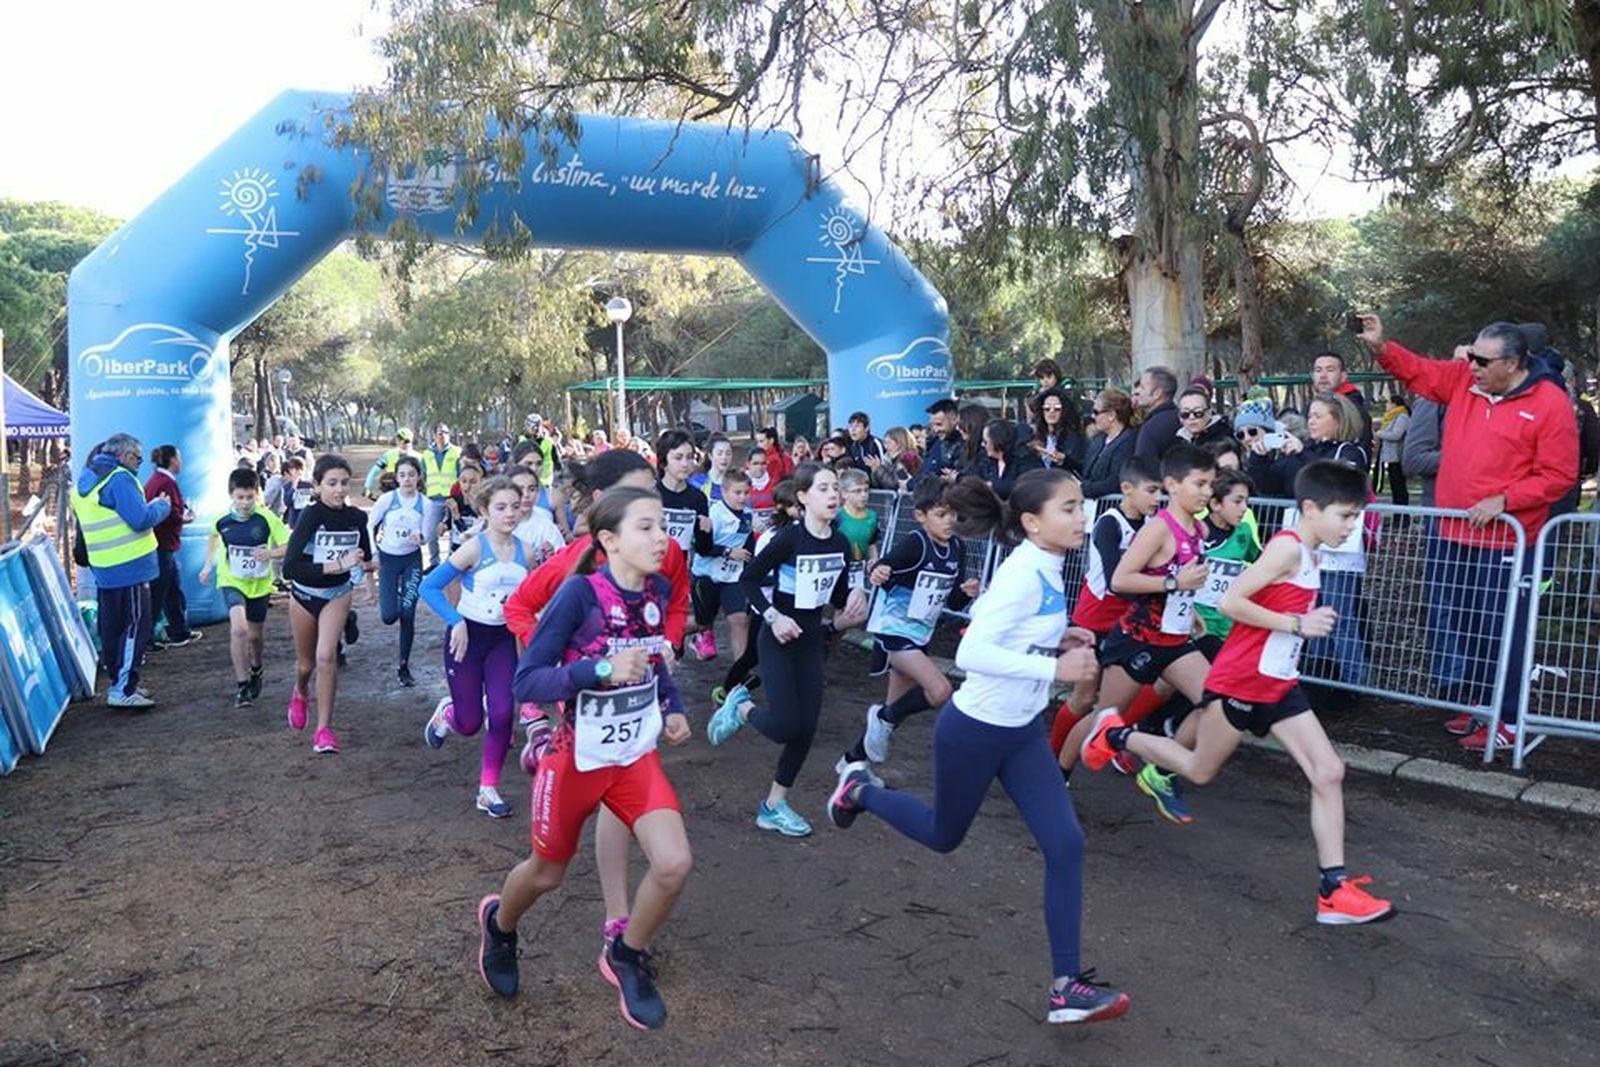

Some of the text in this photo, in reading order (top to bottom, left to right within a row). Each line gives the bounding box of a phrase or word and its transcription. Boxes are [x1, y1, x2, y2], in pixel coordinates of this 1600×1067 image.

[242, 559, 256, 569] 20
[1211, 579, 1230, 593] 30
[600, 717, 643, 744] 257
